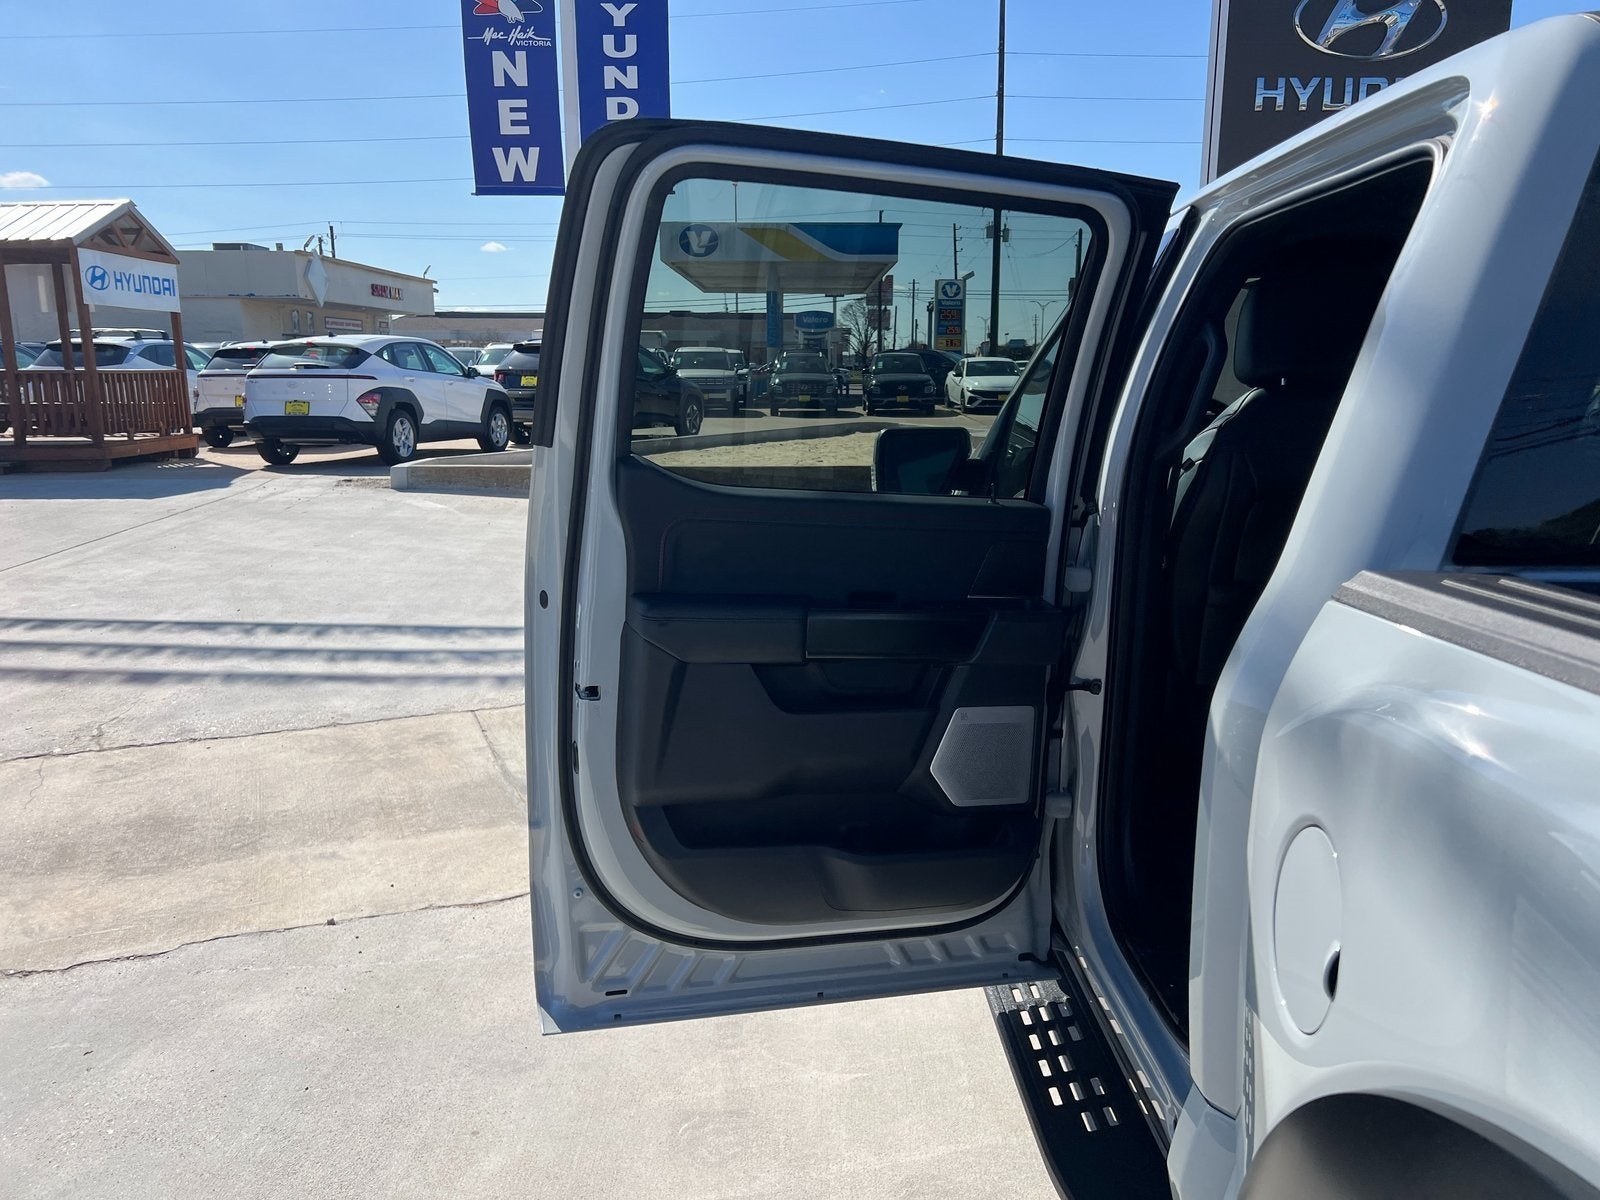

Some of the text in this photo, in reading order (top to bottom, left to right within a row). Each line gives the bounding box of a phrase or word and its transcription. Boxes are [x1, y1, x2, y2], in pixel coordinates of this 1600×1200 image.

[475, 25, 544, 46] Mac Haik
[600, 3, 640, 121] YUND
[1254, 76, 1404, 112] HYUN
[491, 50, 540, 182] NEW
[113, 270, 176, 297] HYUNDAI
[802, 315, 829, 324] Valero
